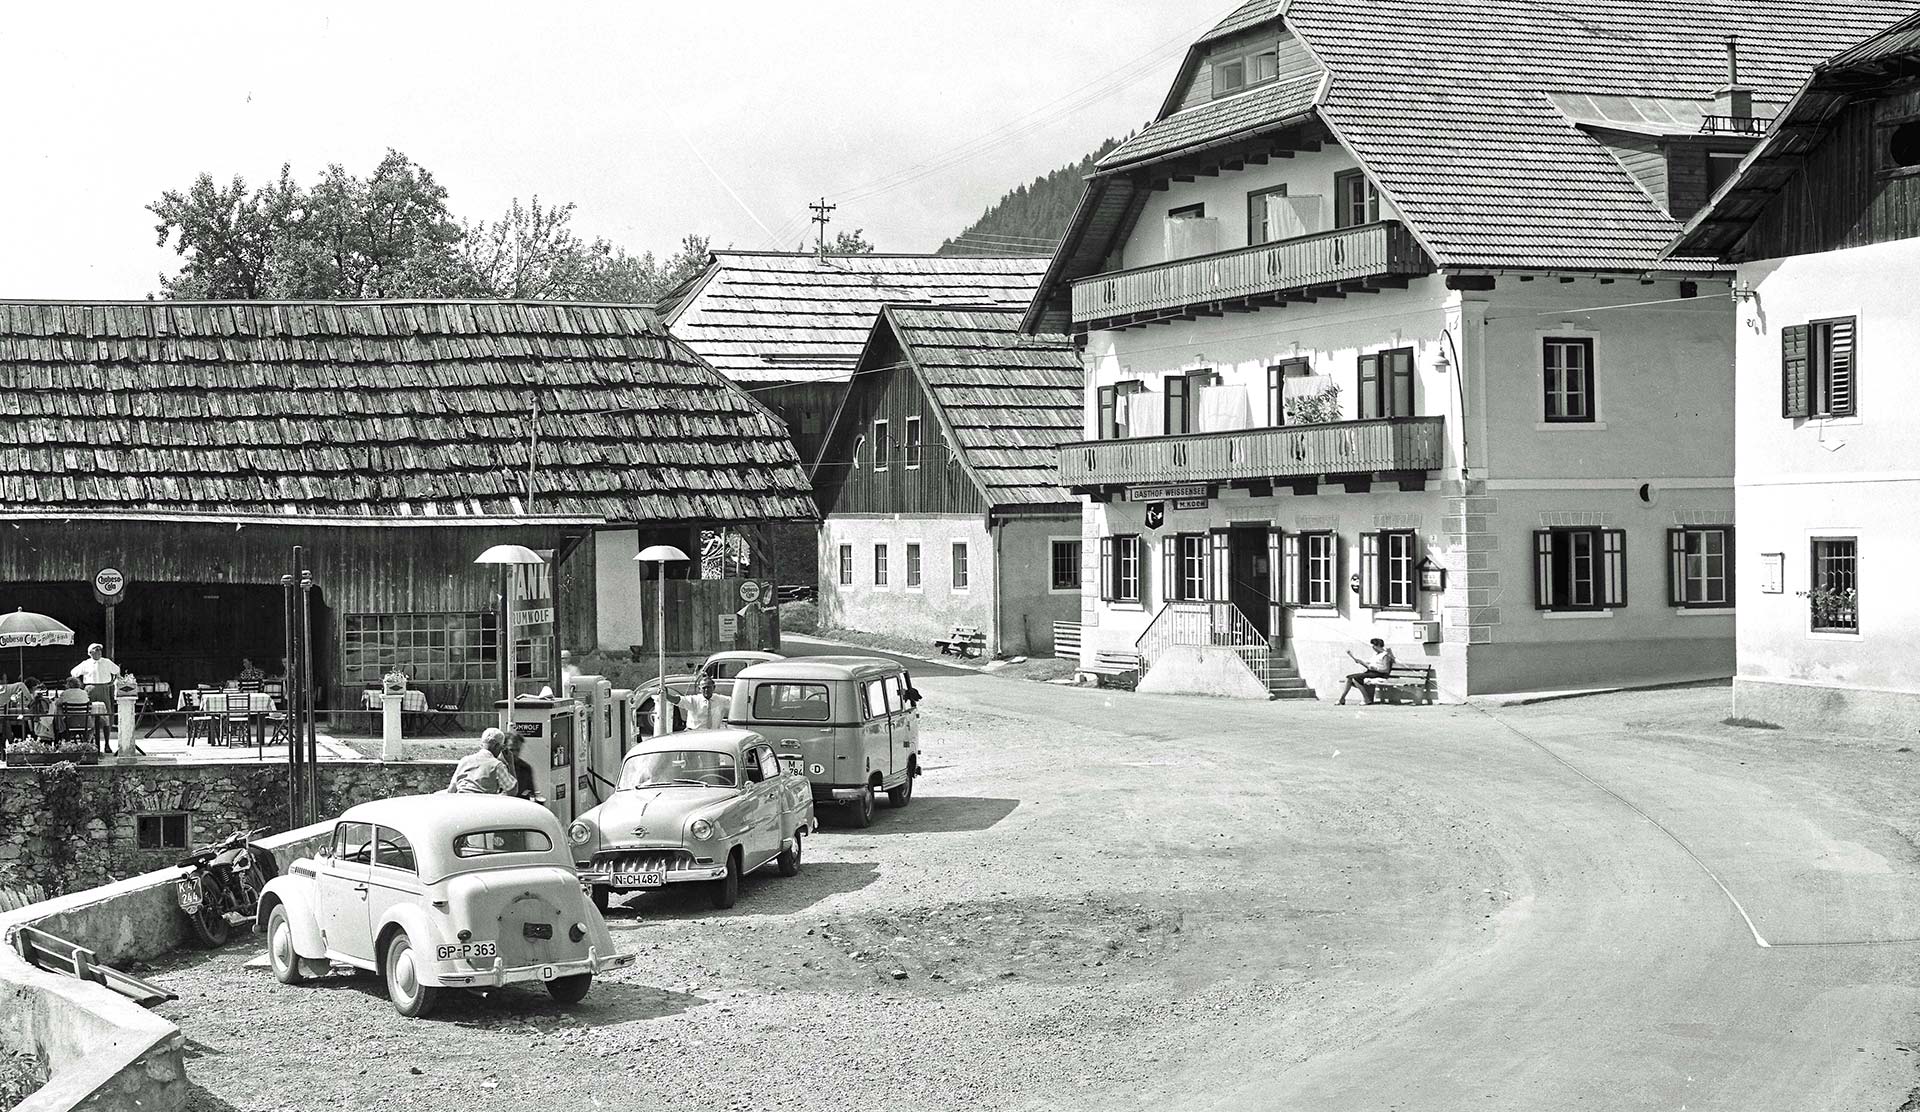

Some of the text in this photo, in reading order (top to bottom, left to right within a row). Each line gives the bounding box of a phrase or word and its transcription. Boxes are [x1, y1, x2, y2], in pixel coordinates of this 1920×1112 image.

[1134, 487, 1205, 499] GASTHOF WEISSENSEE
[814, 765, 821, 773] D
[178, 882, 186, 893] K
[473, 943, 496, 956] 363
